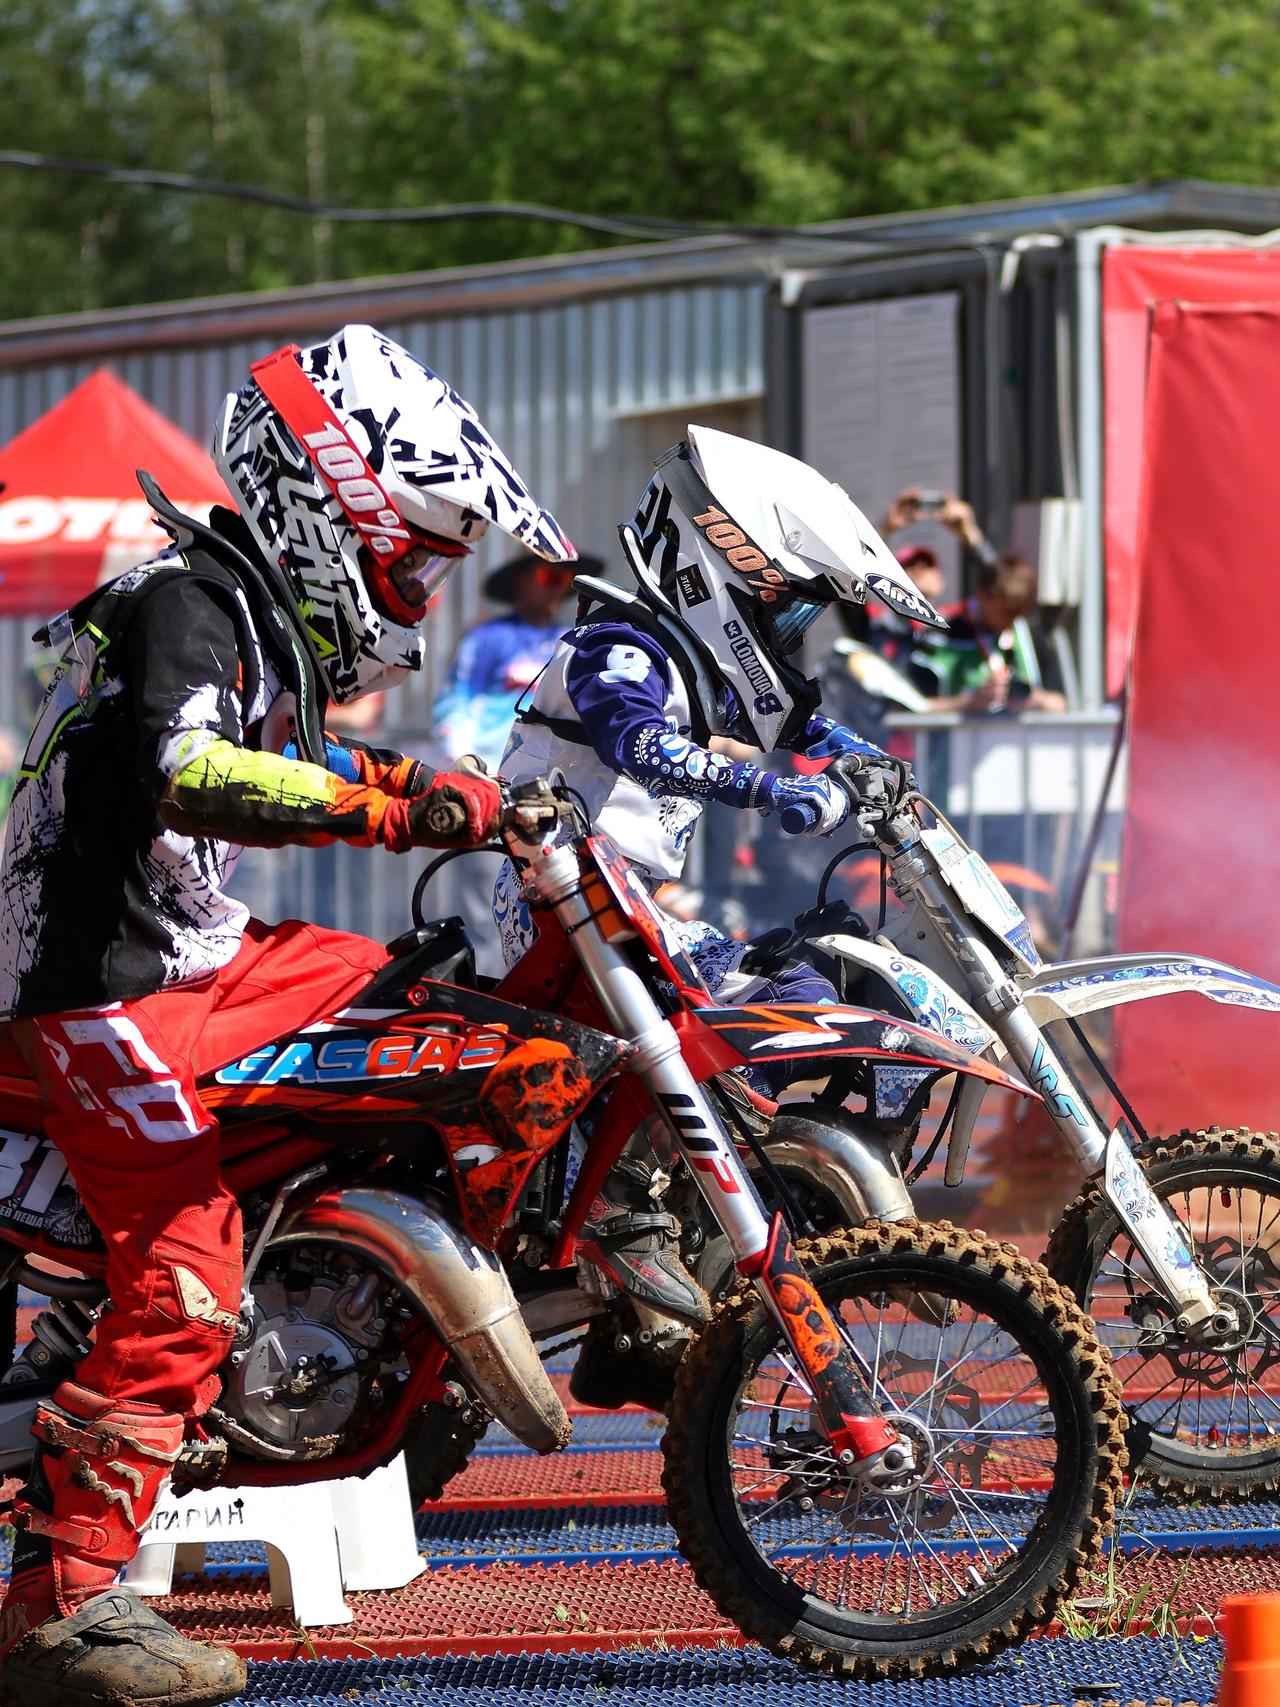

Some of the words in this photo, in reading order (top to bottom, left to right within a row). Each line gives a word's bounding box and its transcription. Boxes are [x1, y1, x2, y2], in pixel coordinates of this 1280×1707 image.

[303, 421, 411, 554] 100%
[693, 505, 789, 602] 100%
[680, 574, 693, 595] ЭТАП
[873, 578, 931, 618] Airoh
[731, 638, 772, 695] LOMOVA
[754, 693, 784, 715] 8
[215, 1023, 509, 1085] GASGAS
[12, 1208, 45, 1229] ЛЕША
[150, 1503, 244, 1531] ГАРИН
